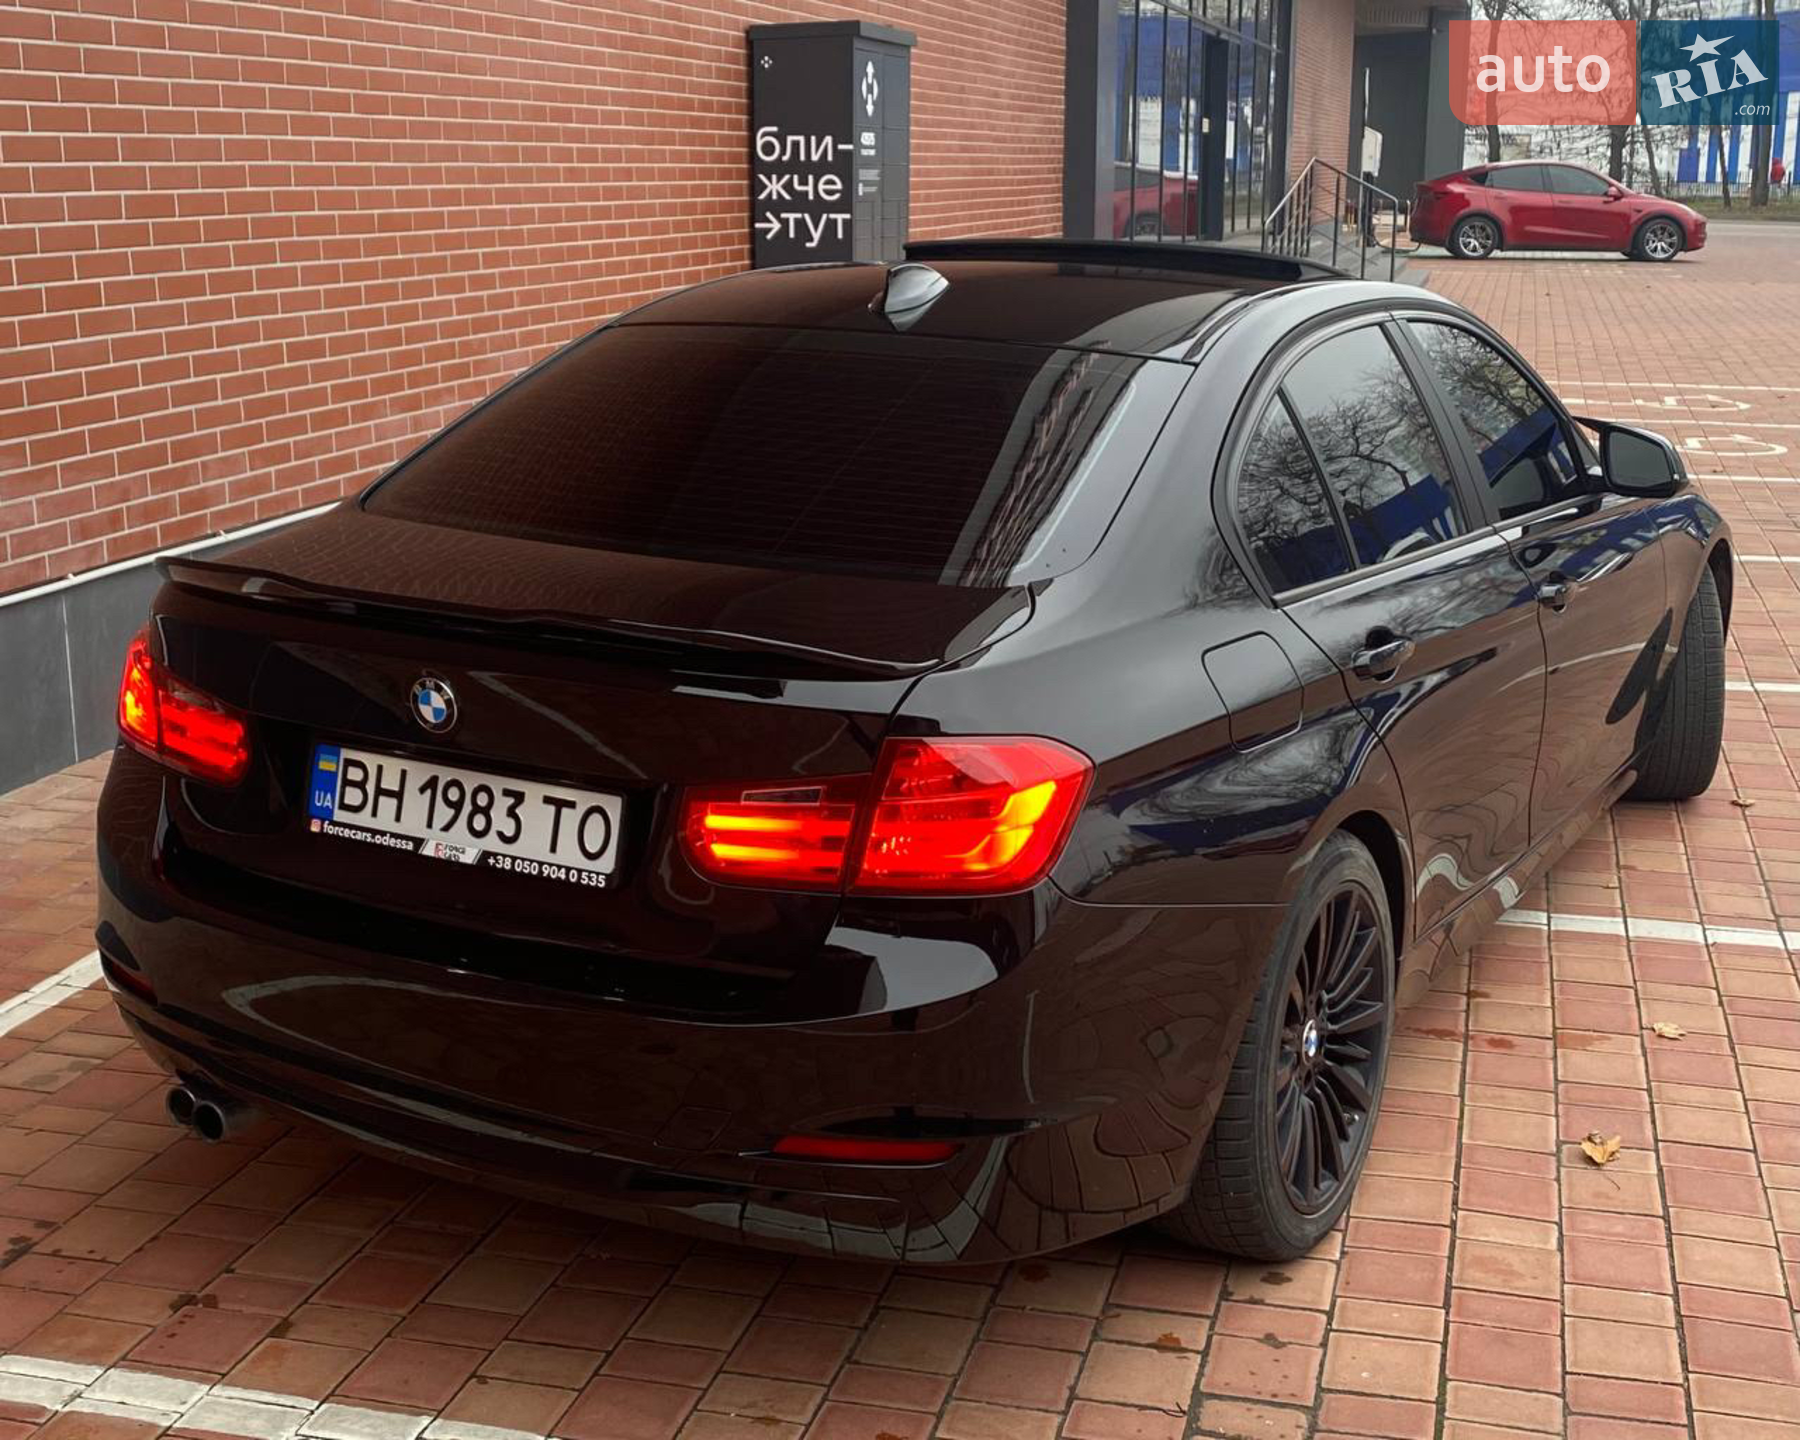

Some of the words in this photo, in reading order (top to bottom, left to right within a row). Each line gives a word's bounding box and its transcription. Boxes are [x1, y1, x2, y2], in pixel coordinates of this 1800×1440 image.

[756, 126, 854, 162] бли-
[757, 174, 843, 201] жче
[780, 213, 851, 247] тут
[314, 790, 333, 810] UA
[338, 757, 407, 823] BH
[418, 774, 526, 845] 1983
[542, 794, 612, 862] TO
[323, 820, 414, 850] forcecars.odessa
[487, 855, 512, 870] +38
[514, 859, 539, 875] 050
[542, 864, 566, 880] 904
[568, 869, 578, 882] 0
[580, 871, 606, 888] 535
